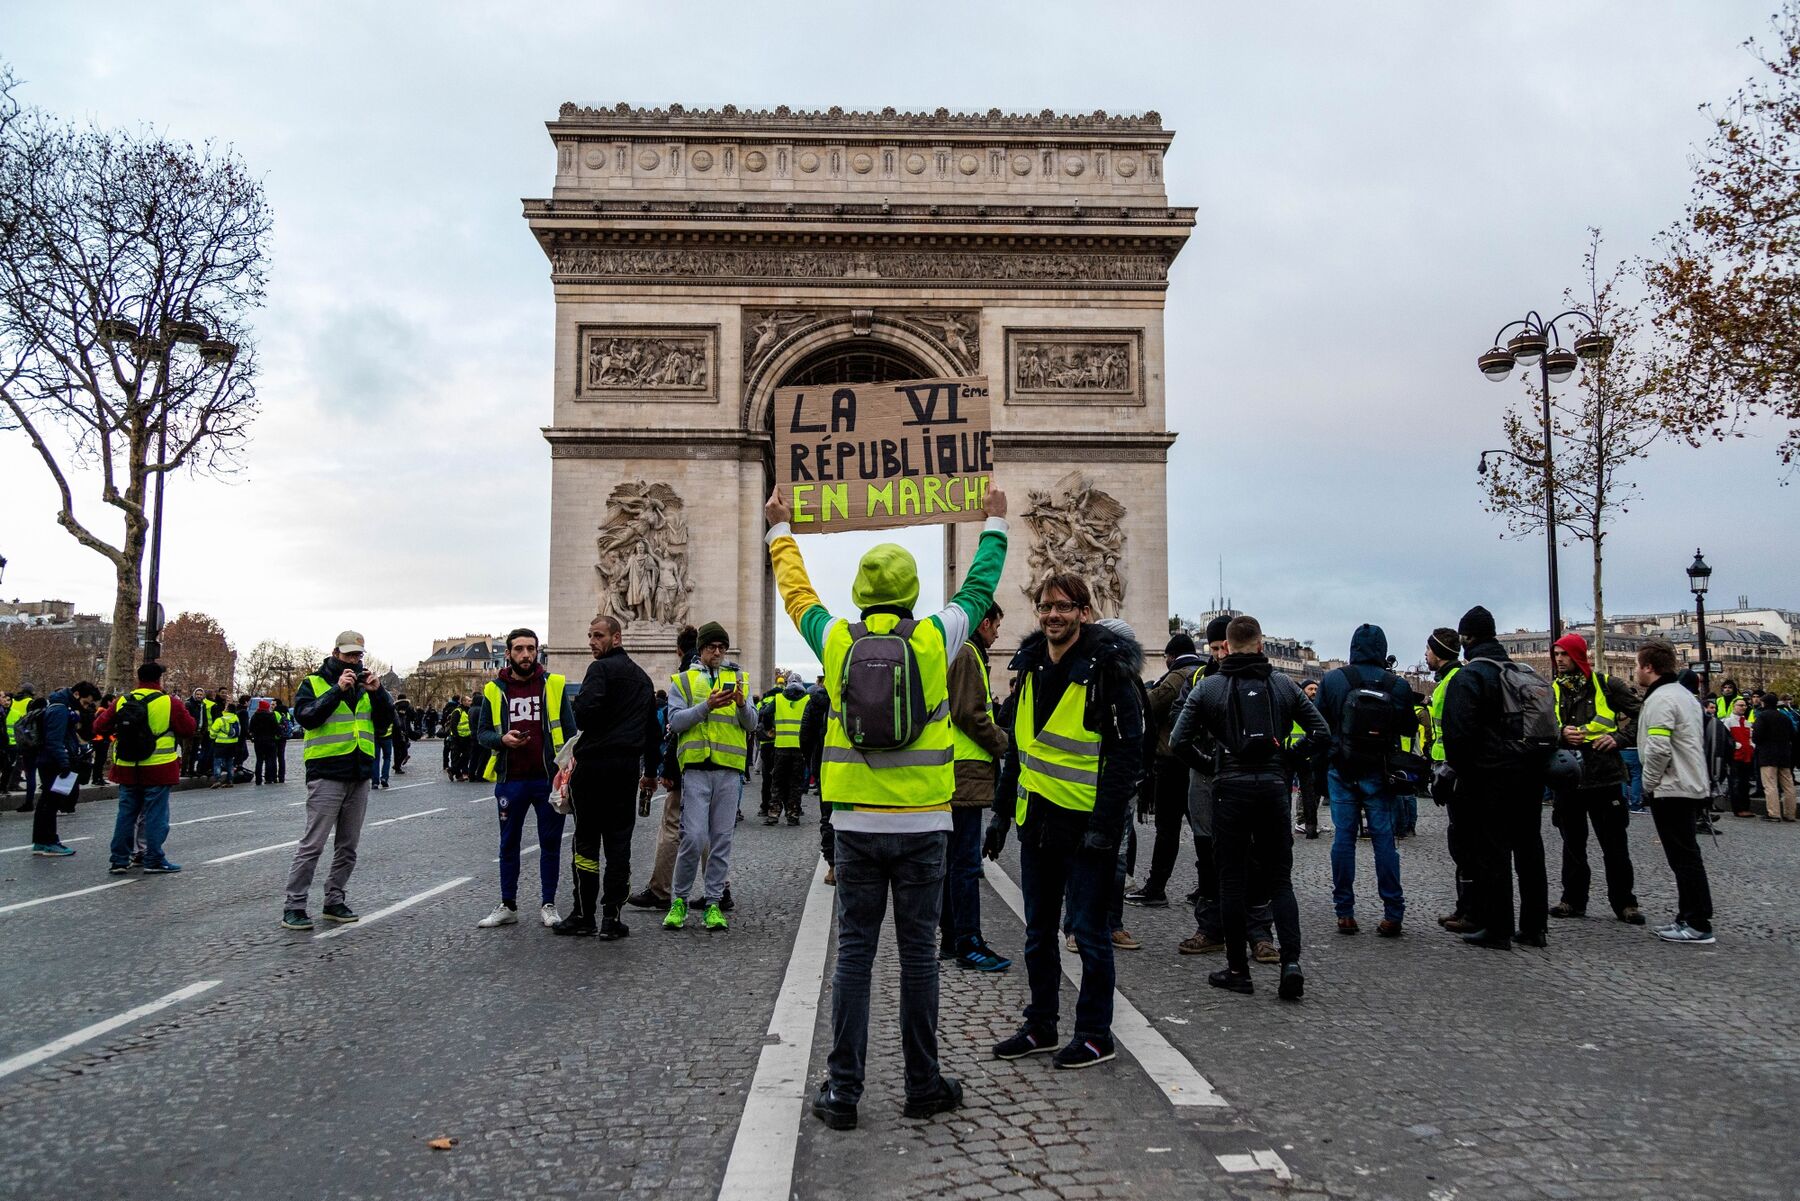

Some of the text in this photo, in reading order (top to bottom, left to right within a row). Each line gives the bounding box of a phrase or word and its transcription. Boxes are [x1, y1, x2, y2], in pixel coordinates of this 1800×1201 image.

[790, 388, 857, 433] LA
[791, 428, 993, 482] RÉPUBLIQUE
[793, 482, 849, 523] EN
